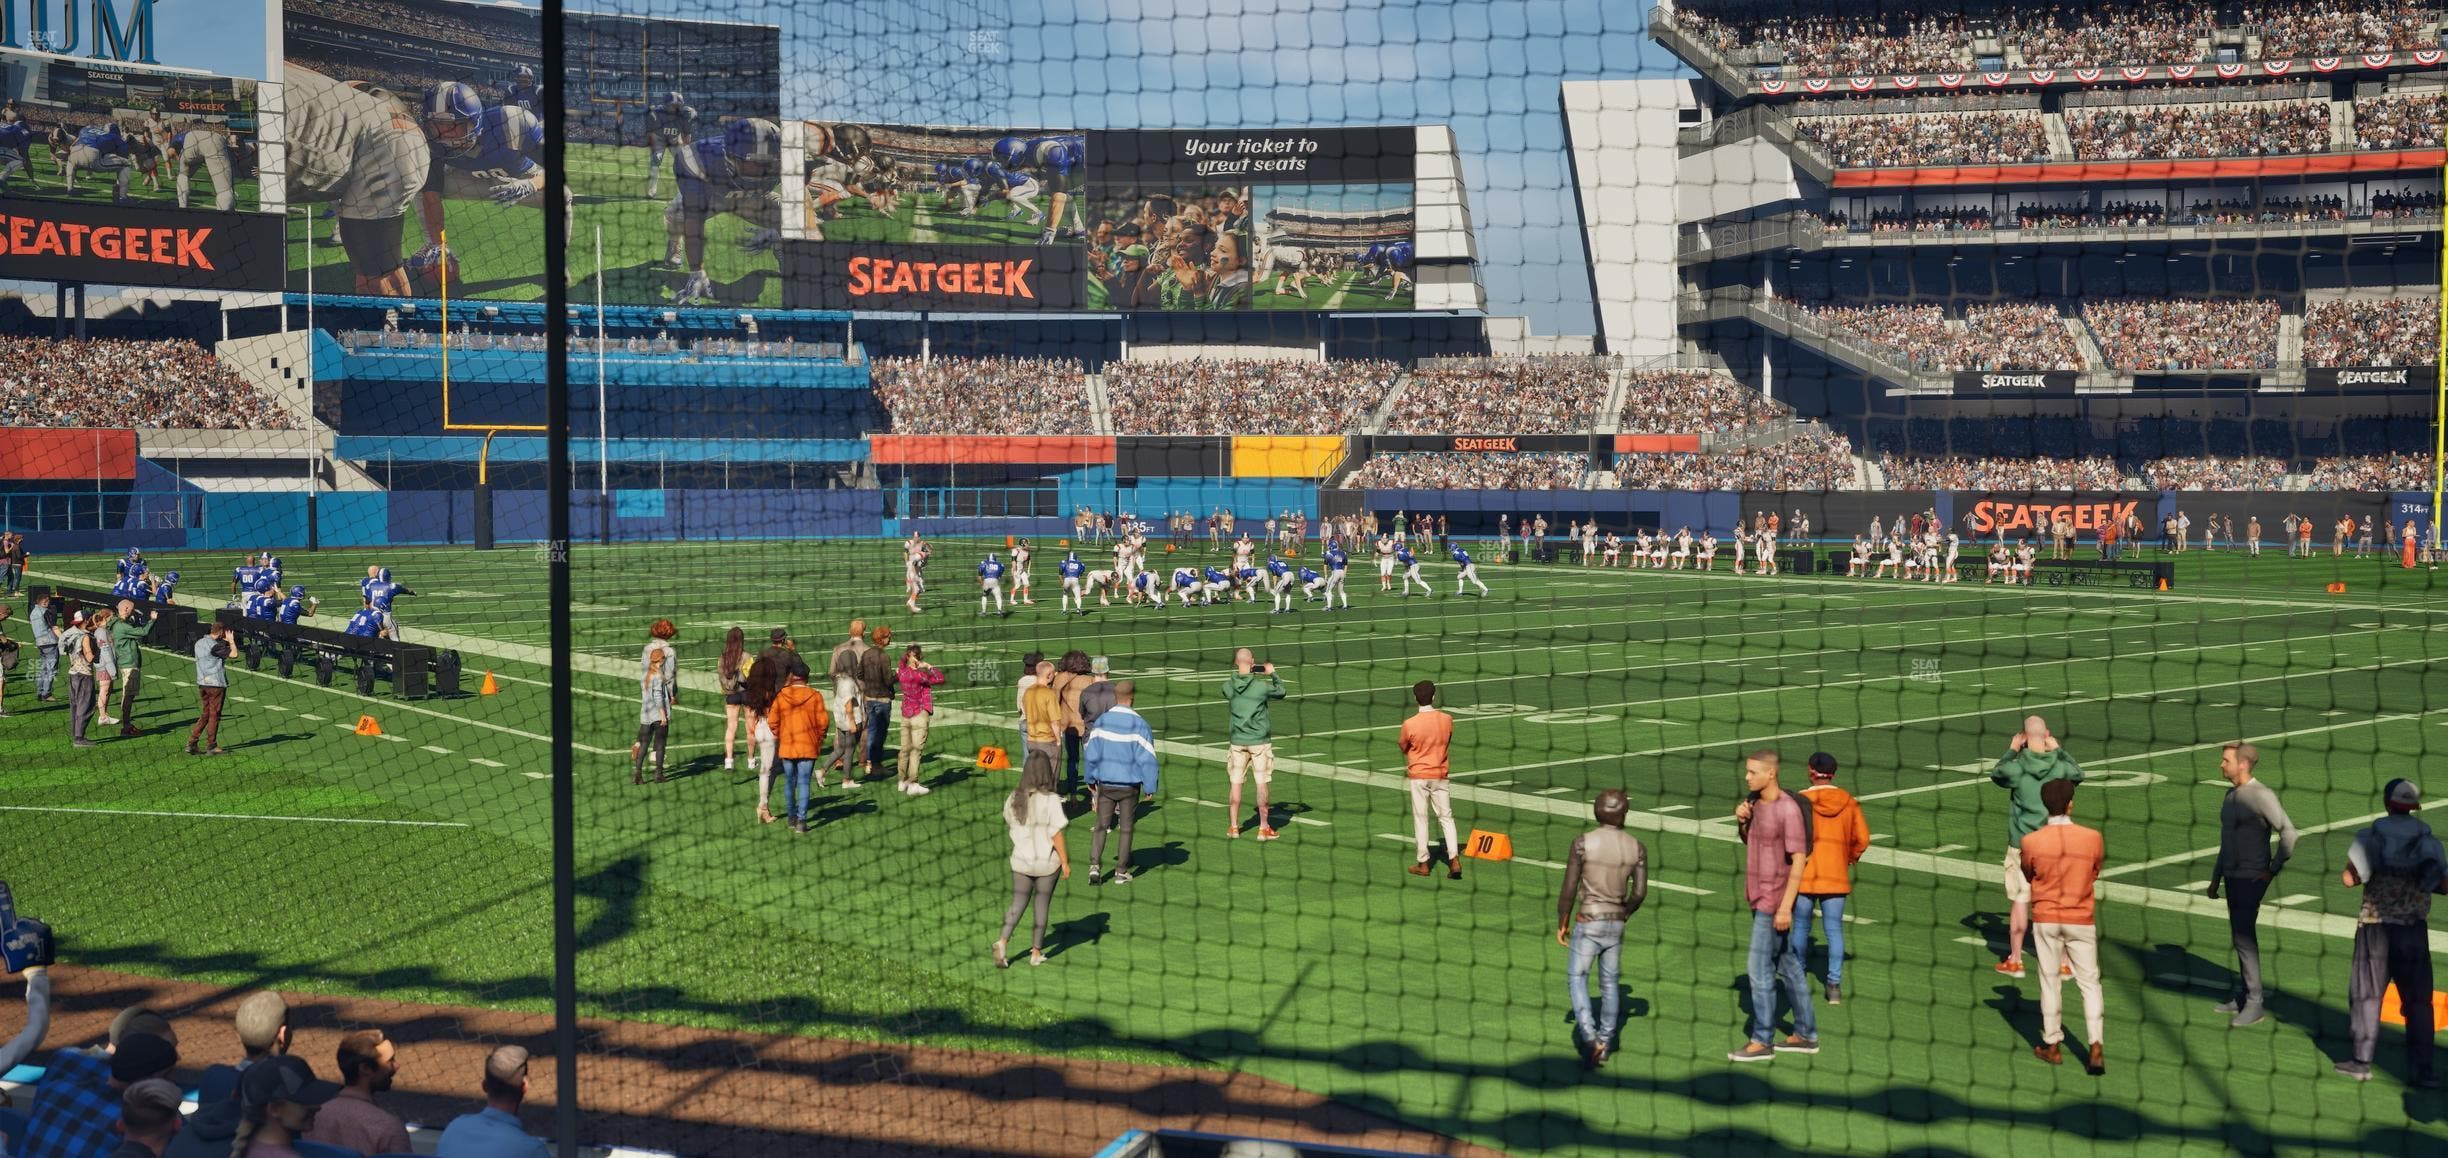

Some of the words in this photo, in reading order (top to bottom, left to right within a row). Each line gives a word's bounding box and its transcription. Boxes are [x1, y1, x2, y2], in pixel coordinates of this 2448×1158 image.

[178, 101, 226, 112] SEATGEEK
[1185, 139, 1232, 156] Your
[1237, 138, 1294, 154] ticket
[1299, 138, 1318, 153] to
[1196, 157, 1250, 176] great
[1253, 156, 1307, 171] seats
[848, 256, 1034, 299] SEATGEEK
[1982, 374, 2046, 388] SEATGEEK
[2337, 370, 2407, 385] SEATGEEK
[1455, 437, 1517, 451] SEATGEEK
[1974, 501, 2138, 533] SEATGEEK
[983, 750, 996, 764] 20
[1478, 835, 1493, 854] 10
